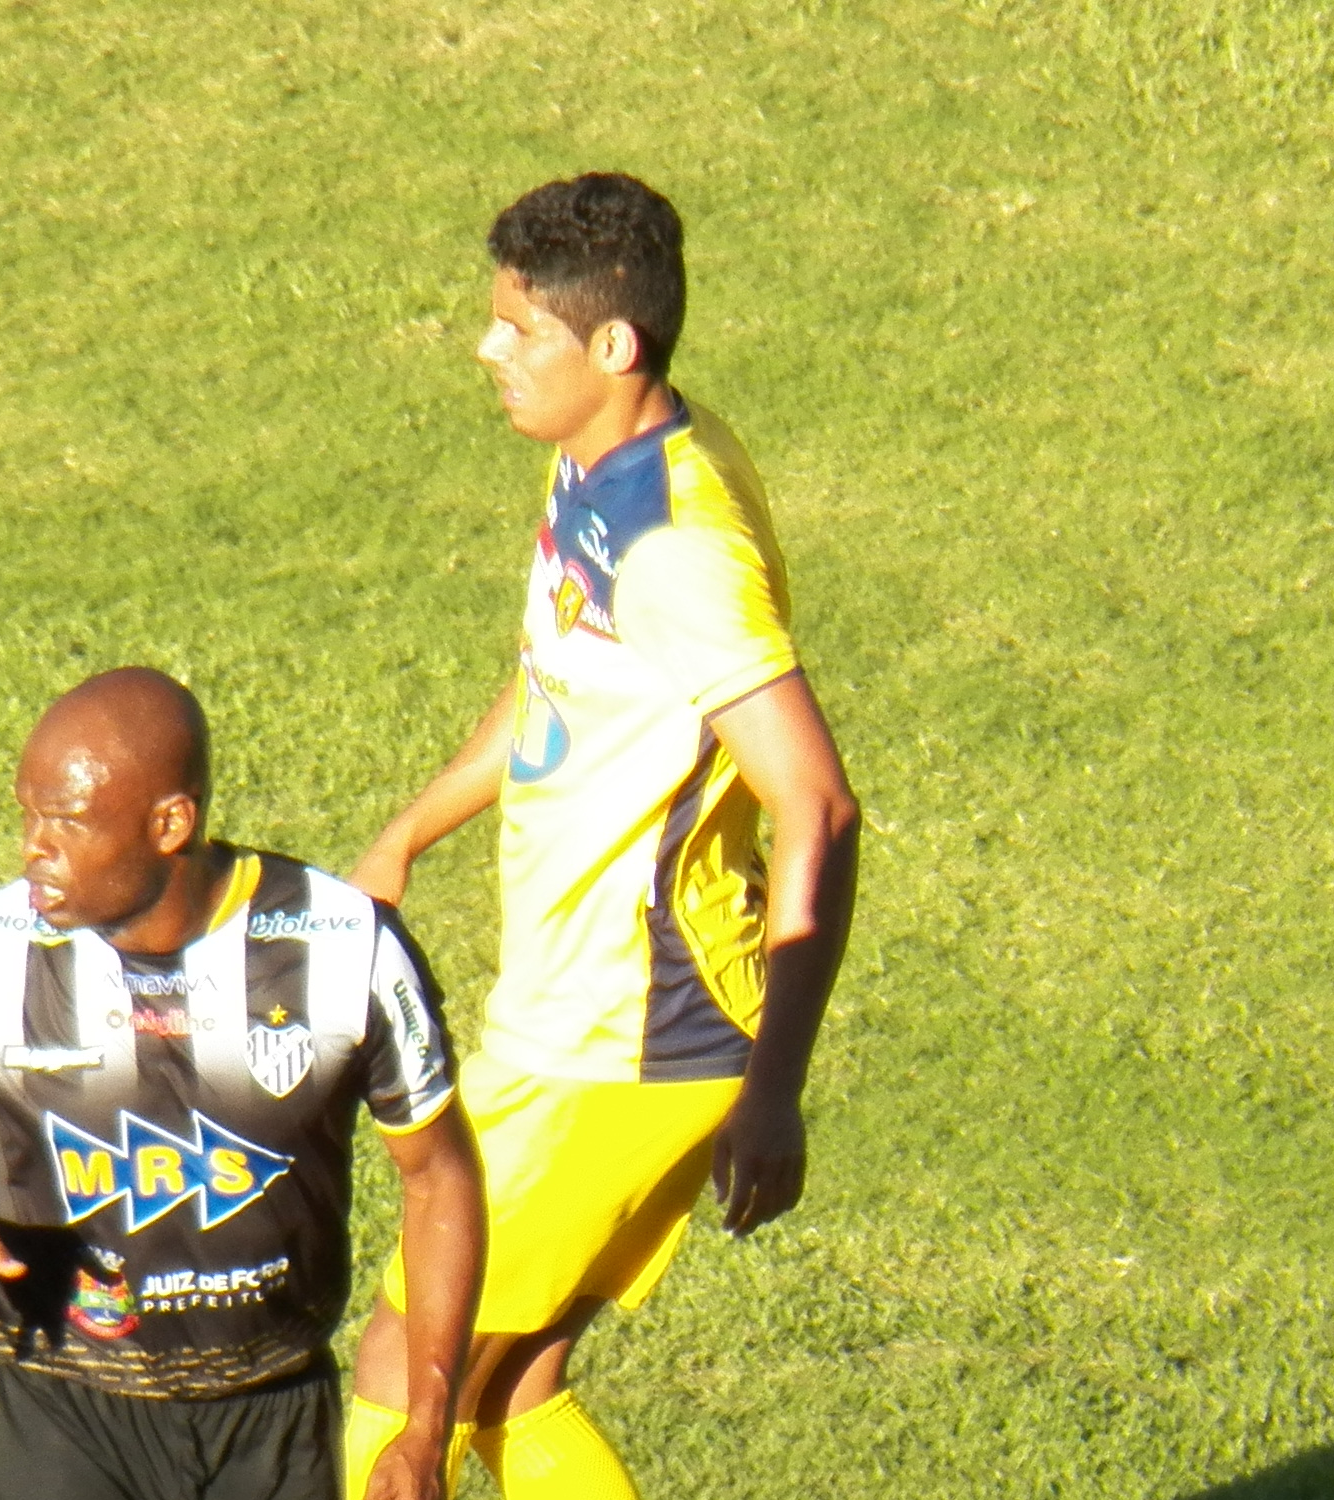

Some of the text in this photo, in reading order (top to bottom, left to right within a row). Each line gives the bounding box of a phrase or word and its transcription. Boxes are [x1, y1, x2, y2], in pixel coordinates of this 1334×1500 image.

[250, 910, 362, 937] bioleve
[60, 1145, 255, 1196] MRS
[141, 1270, 195, 1298] JUIZ
[199, 1272, 229, 1293] DE
